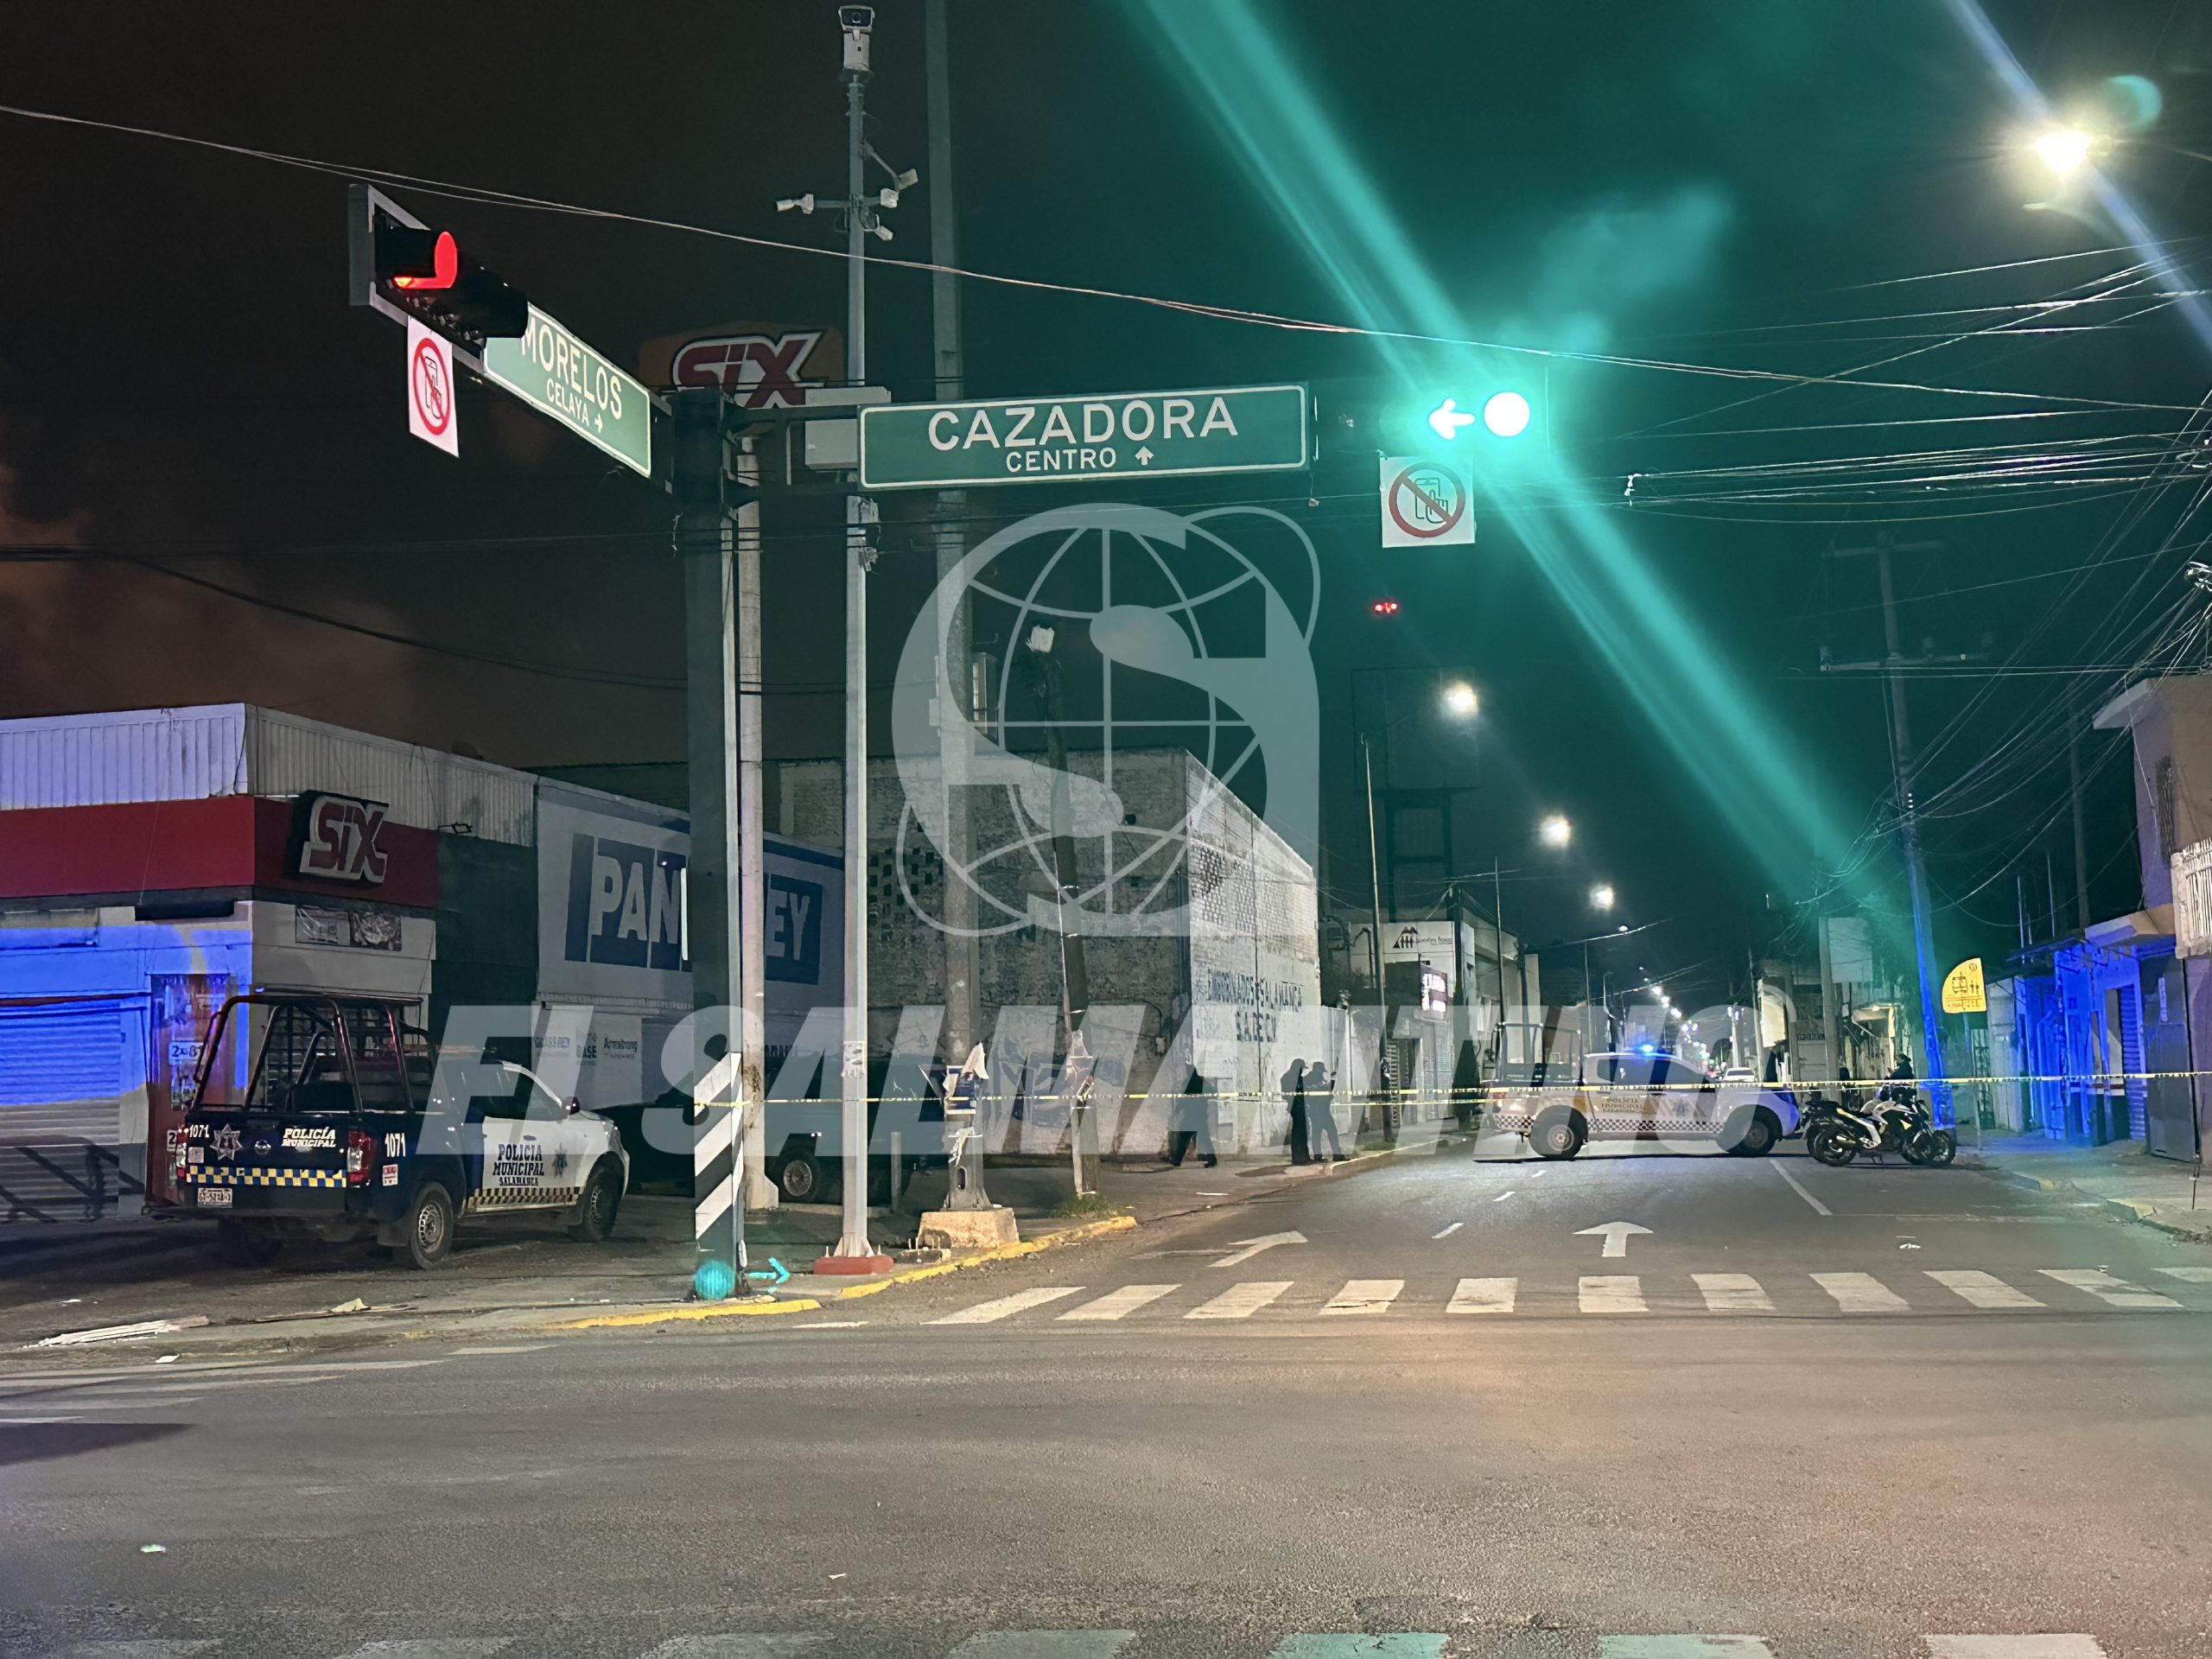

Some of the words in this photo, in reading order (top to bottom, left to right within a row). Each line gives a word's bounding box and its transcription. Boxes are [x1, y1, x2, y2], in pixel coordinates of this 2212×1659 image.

[521, 316, 622, 420] MORELOS
[546, 378, 589, 427] CELAYA
[928, 396, 1238, 451] CAZADORA
[1006, 447, 1116, 473] CENTRO
[188, 1124, 210, 1138] 1071
[281, 1138, 337, 1148] MUNICIPAL
[384, 1133, 407, 1157] 1071
[497, 1143, 543, 1161] POLICIA
[493, 1162, 545, 1176] MUNICIPAL
[499, 1177, 539, 1186] SALAMANCA
